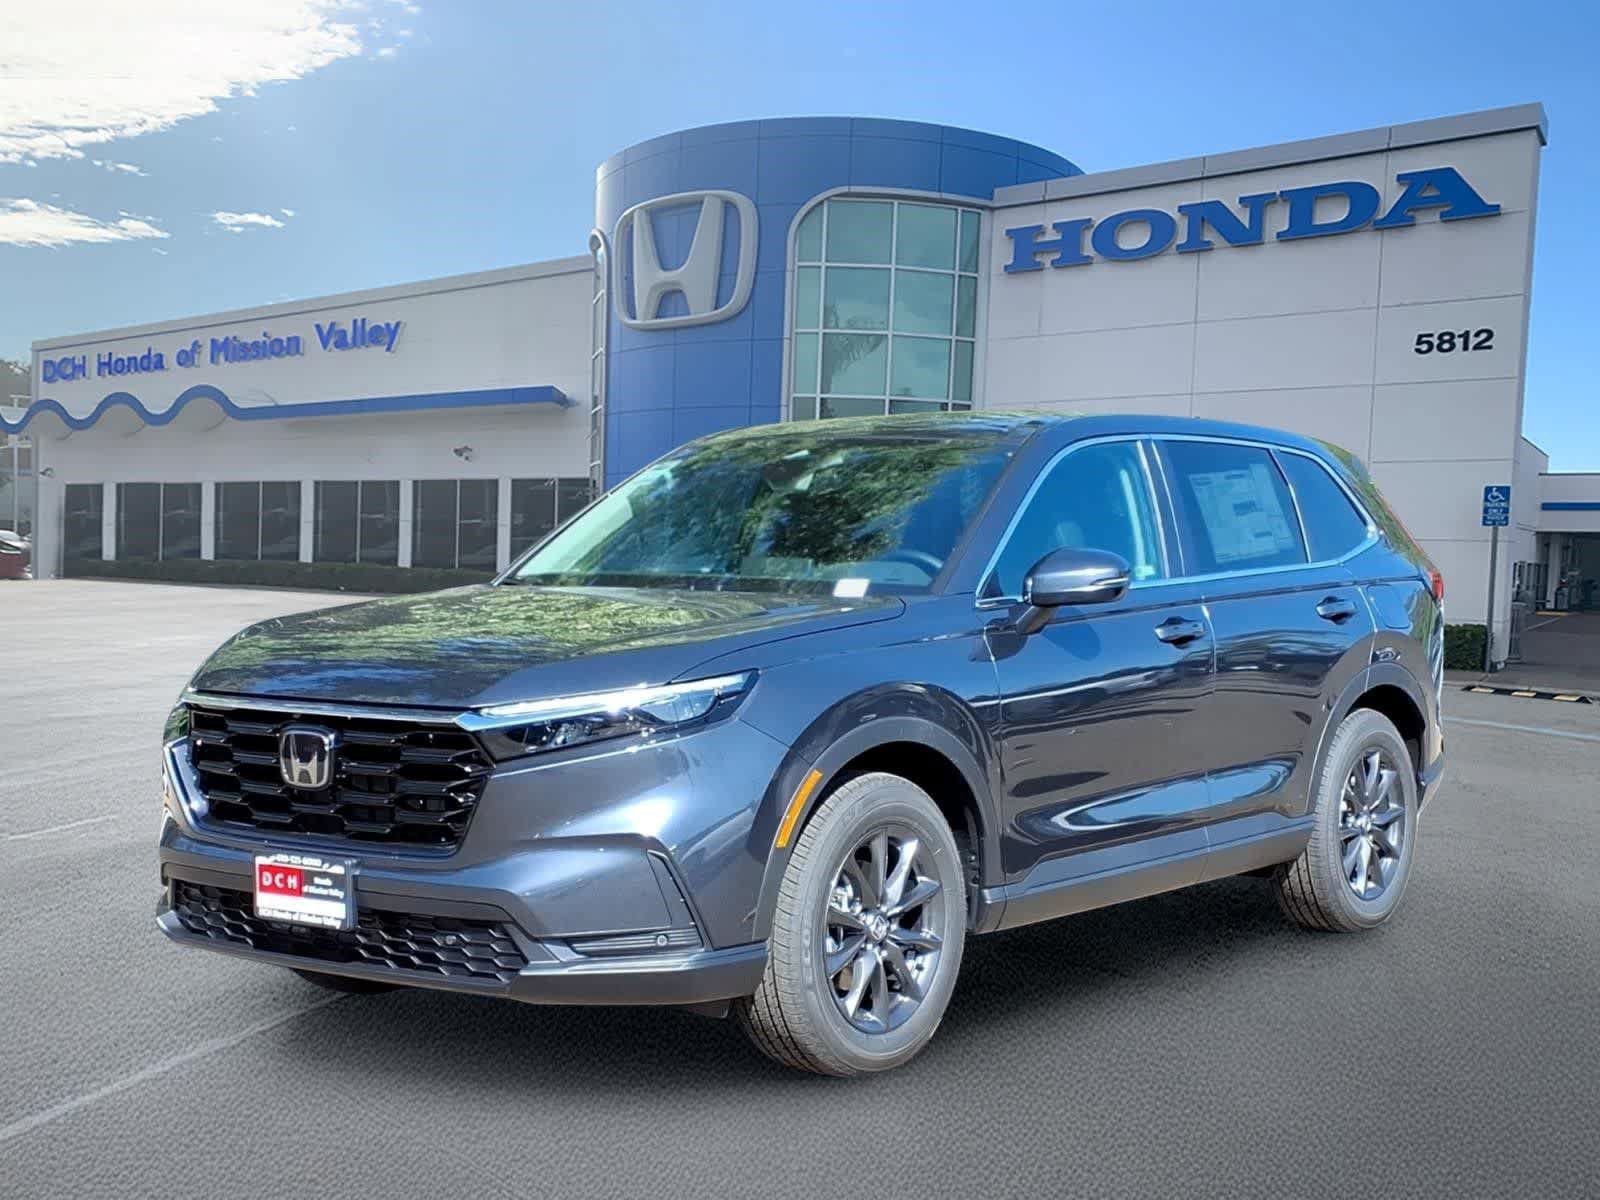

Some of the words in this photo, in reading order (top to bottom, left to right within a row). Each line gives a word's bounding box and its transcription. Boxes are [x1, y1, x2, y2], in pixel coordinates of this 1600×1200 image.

[1004, 166, 1501, 273] HONDA
[42, 354, 87, 383] DCH
[96, 347, 165, 377] Honda
[176, 339, 202, 367] of
[210, 331, 301, 364] Mission
[314, 317, 401, 353] Valley
[1414, 328, 1495, 355] 5812
[261, 871, 298, 890] DCH
